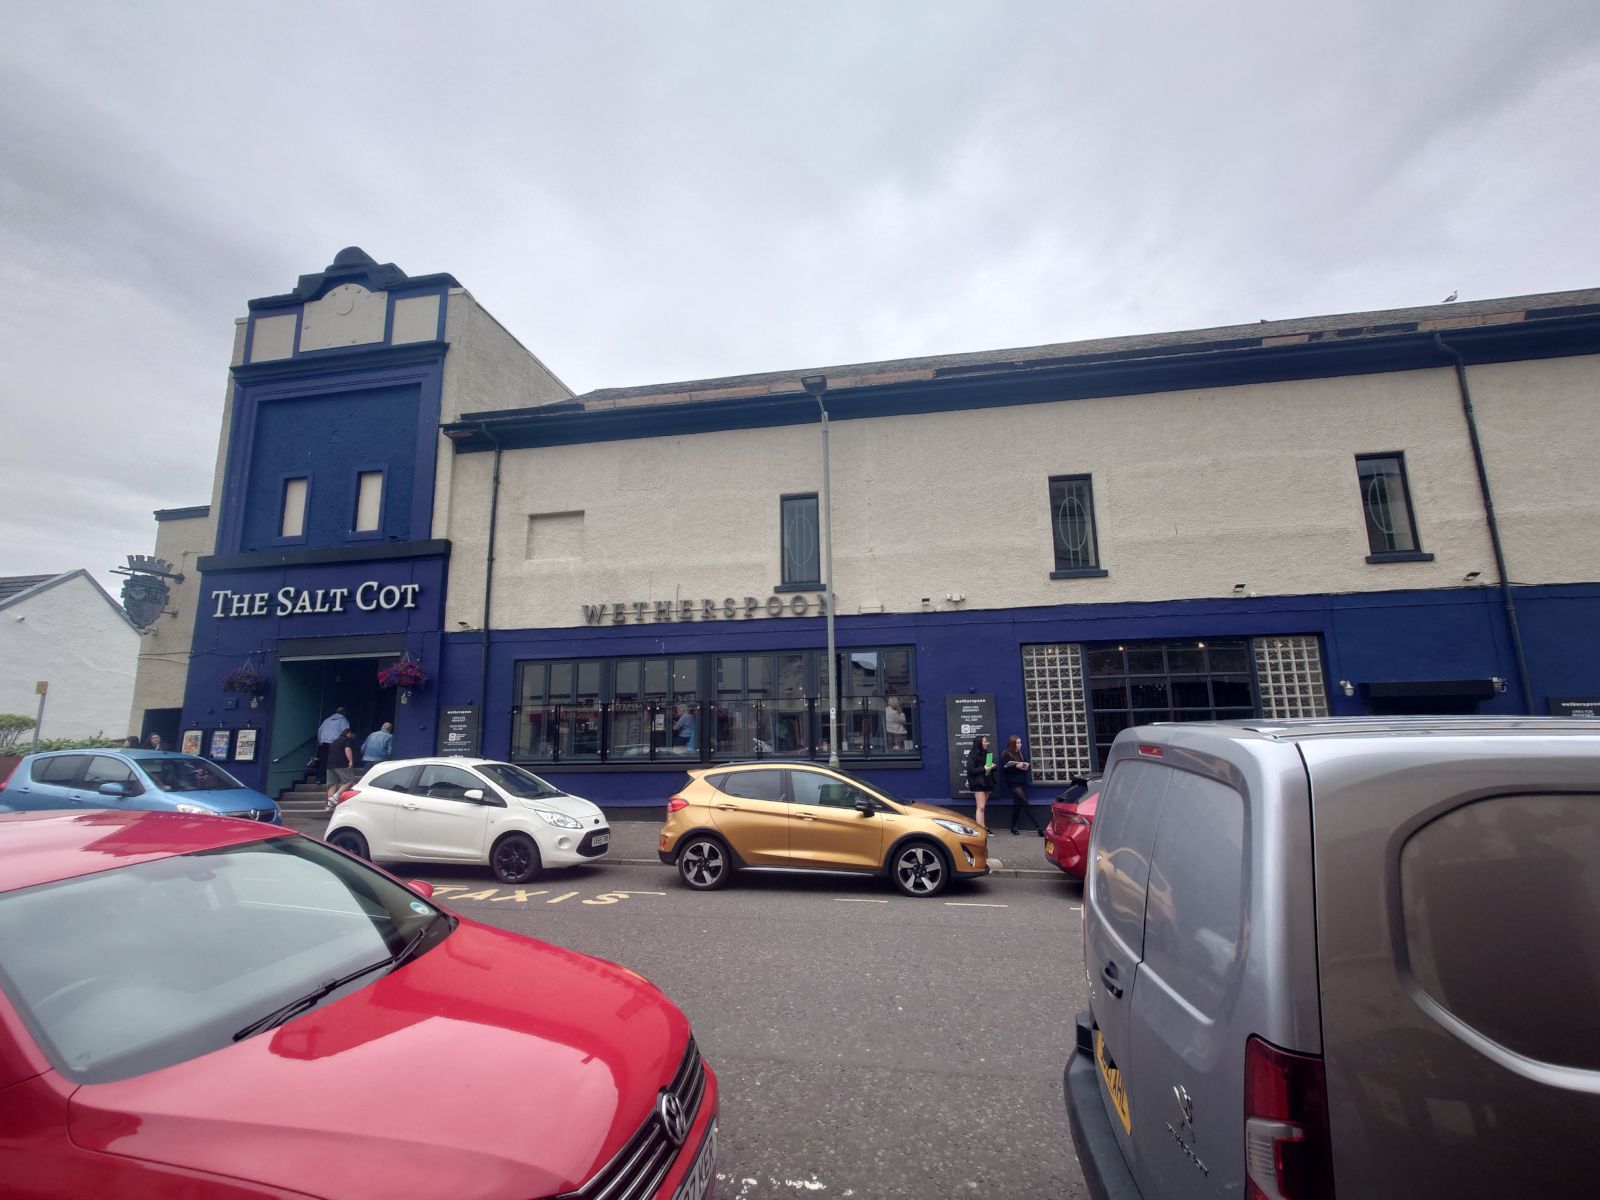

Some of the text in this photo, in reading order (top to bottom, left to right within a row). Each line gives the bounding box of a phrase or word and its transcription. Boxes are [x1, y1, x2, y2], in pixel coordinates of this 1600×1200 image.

[212, 581, 420, 618] THE SALT COT
[431, 887, 630, 904] TAXIS
